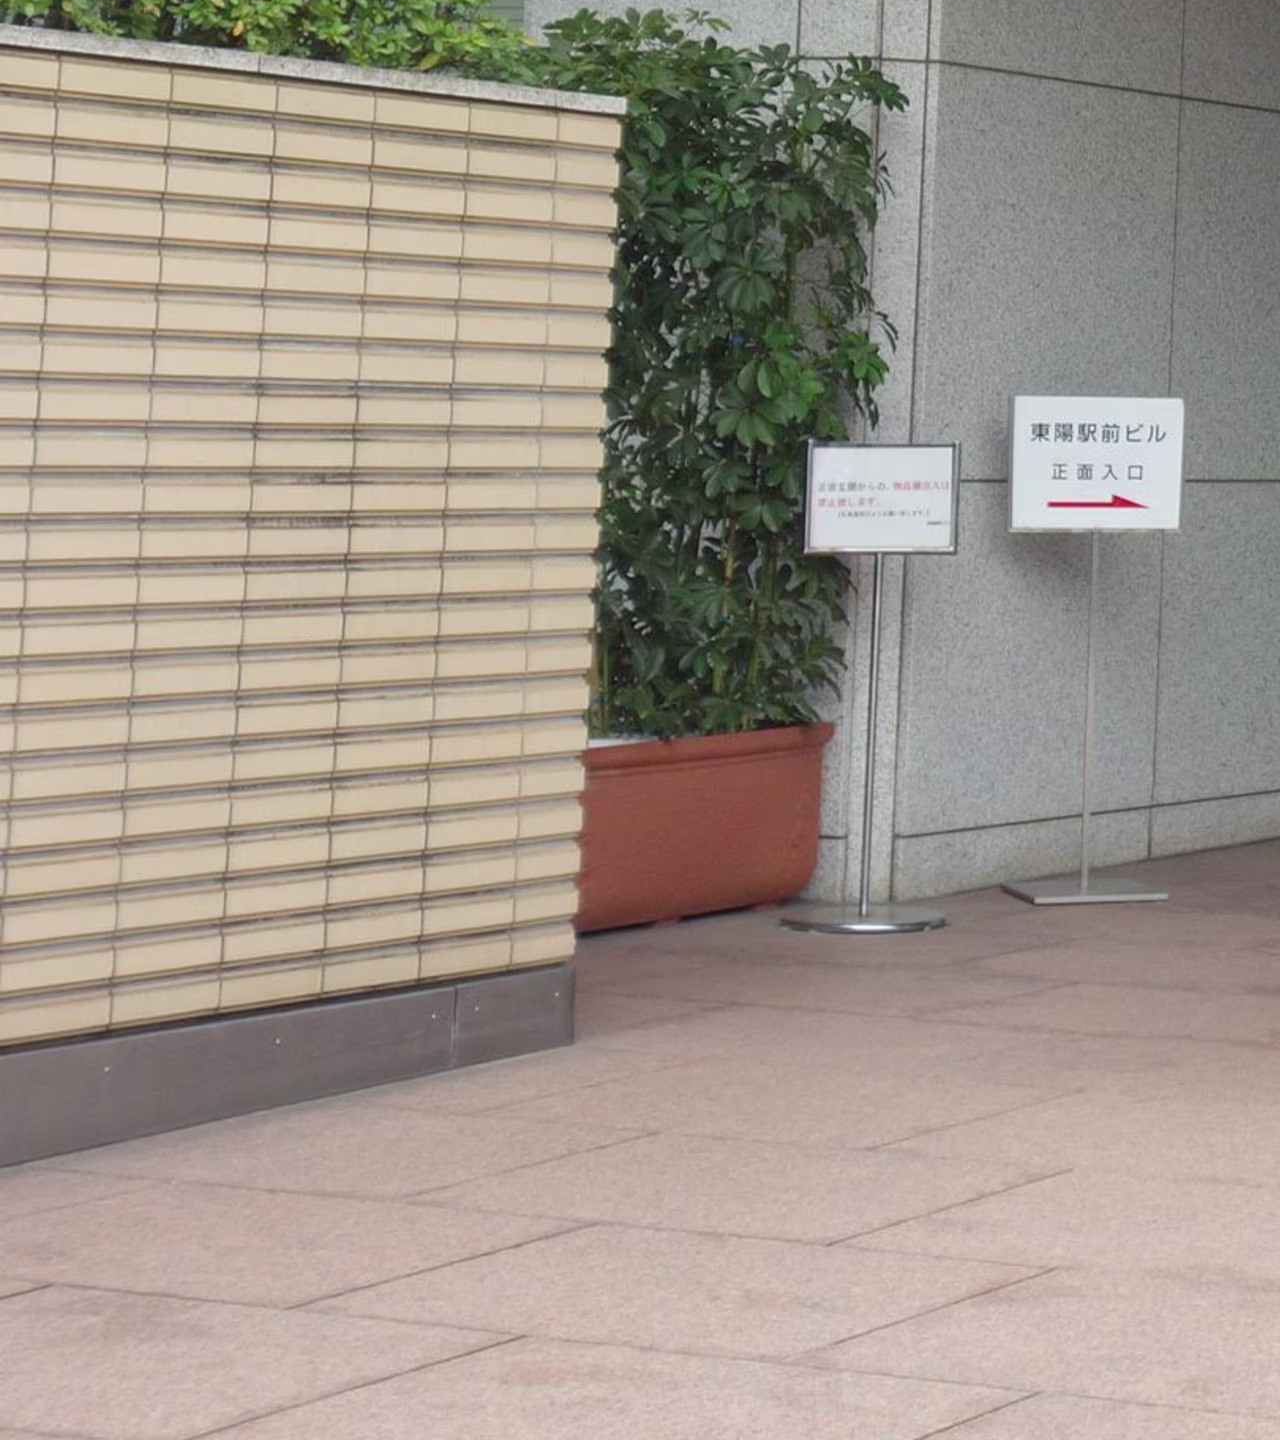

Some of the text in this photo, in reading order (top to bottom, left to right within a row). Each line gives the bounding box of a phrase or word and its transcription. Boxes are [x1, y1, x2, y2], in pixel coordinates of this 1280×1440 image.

[1029, 421, 1168, 445] 東陽駅前ビル
[1051, 463, 1145, 481] 正面入口
